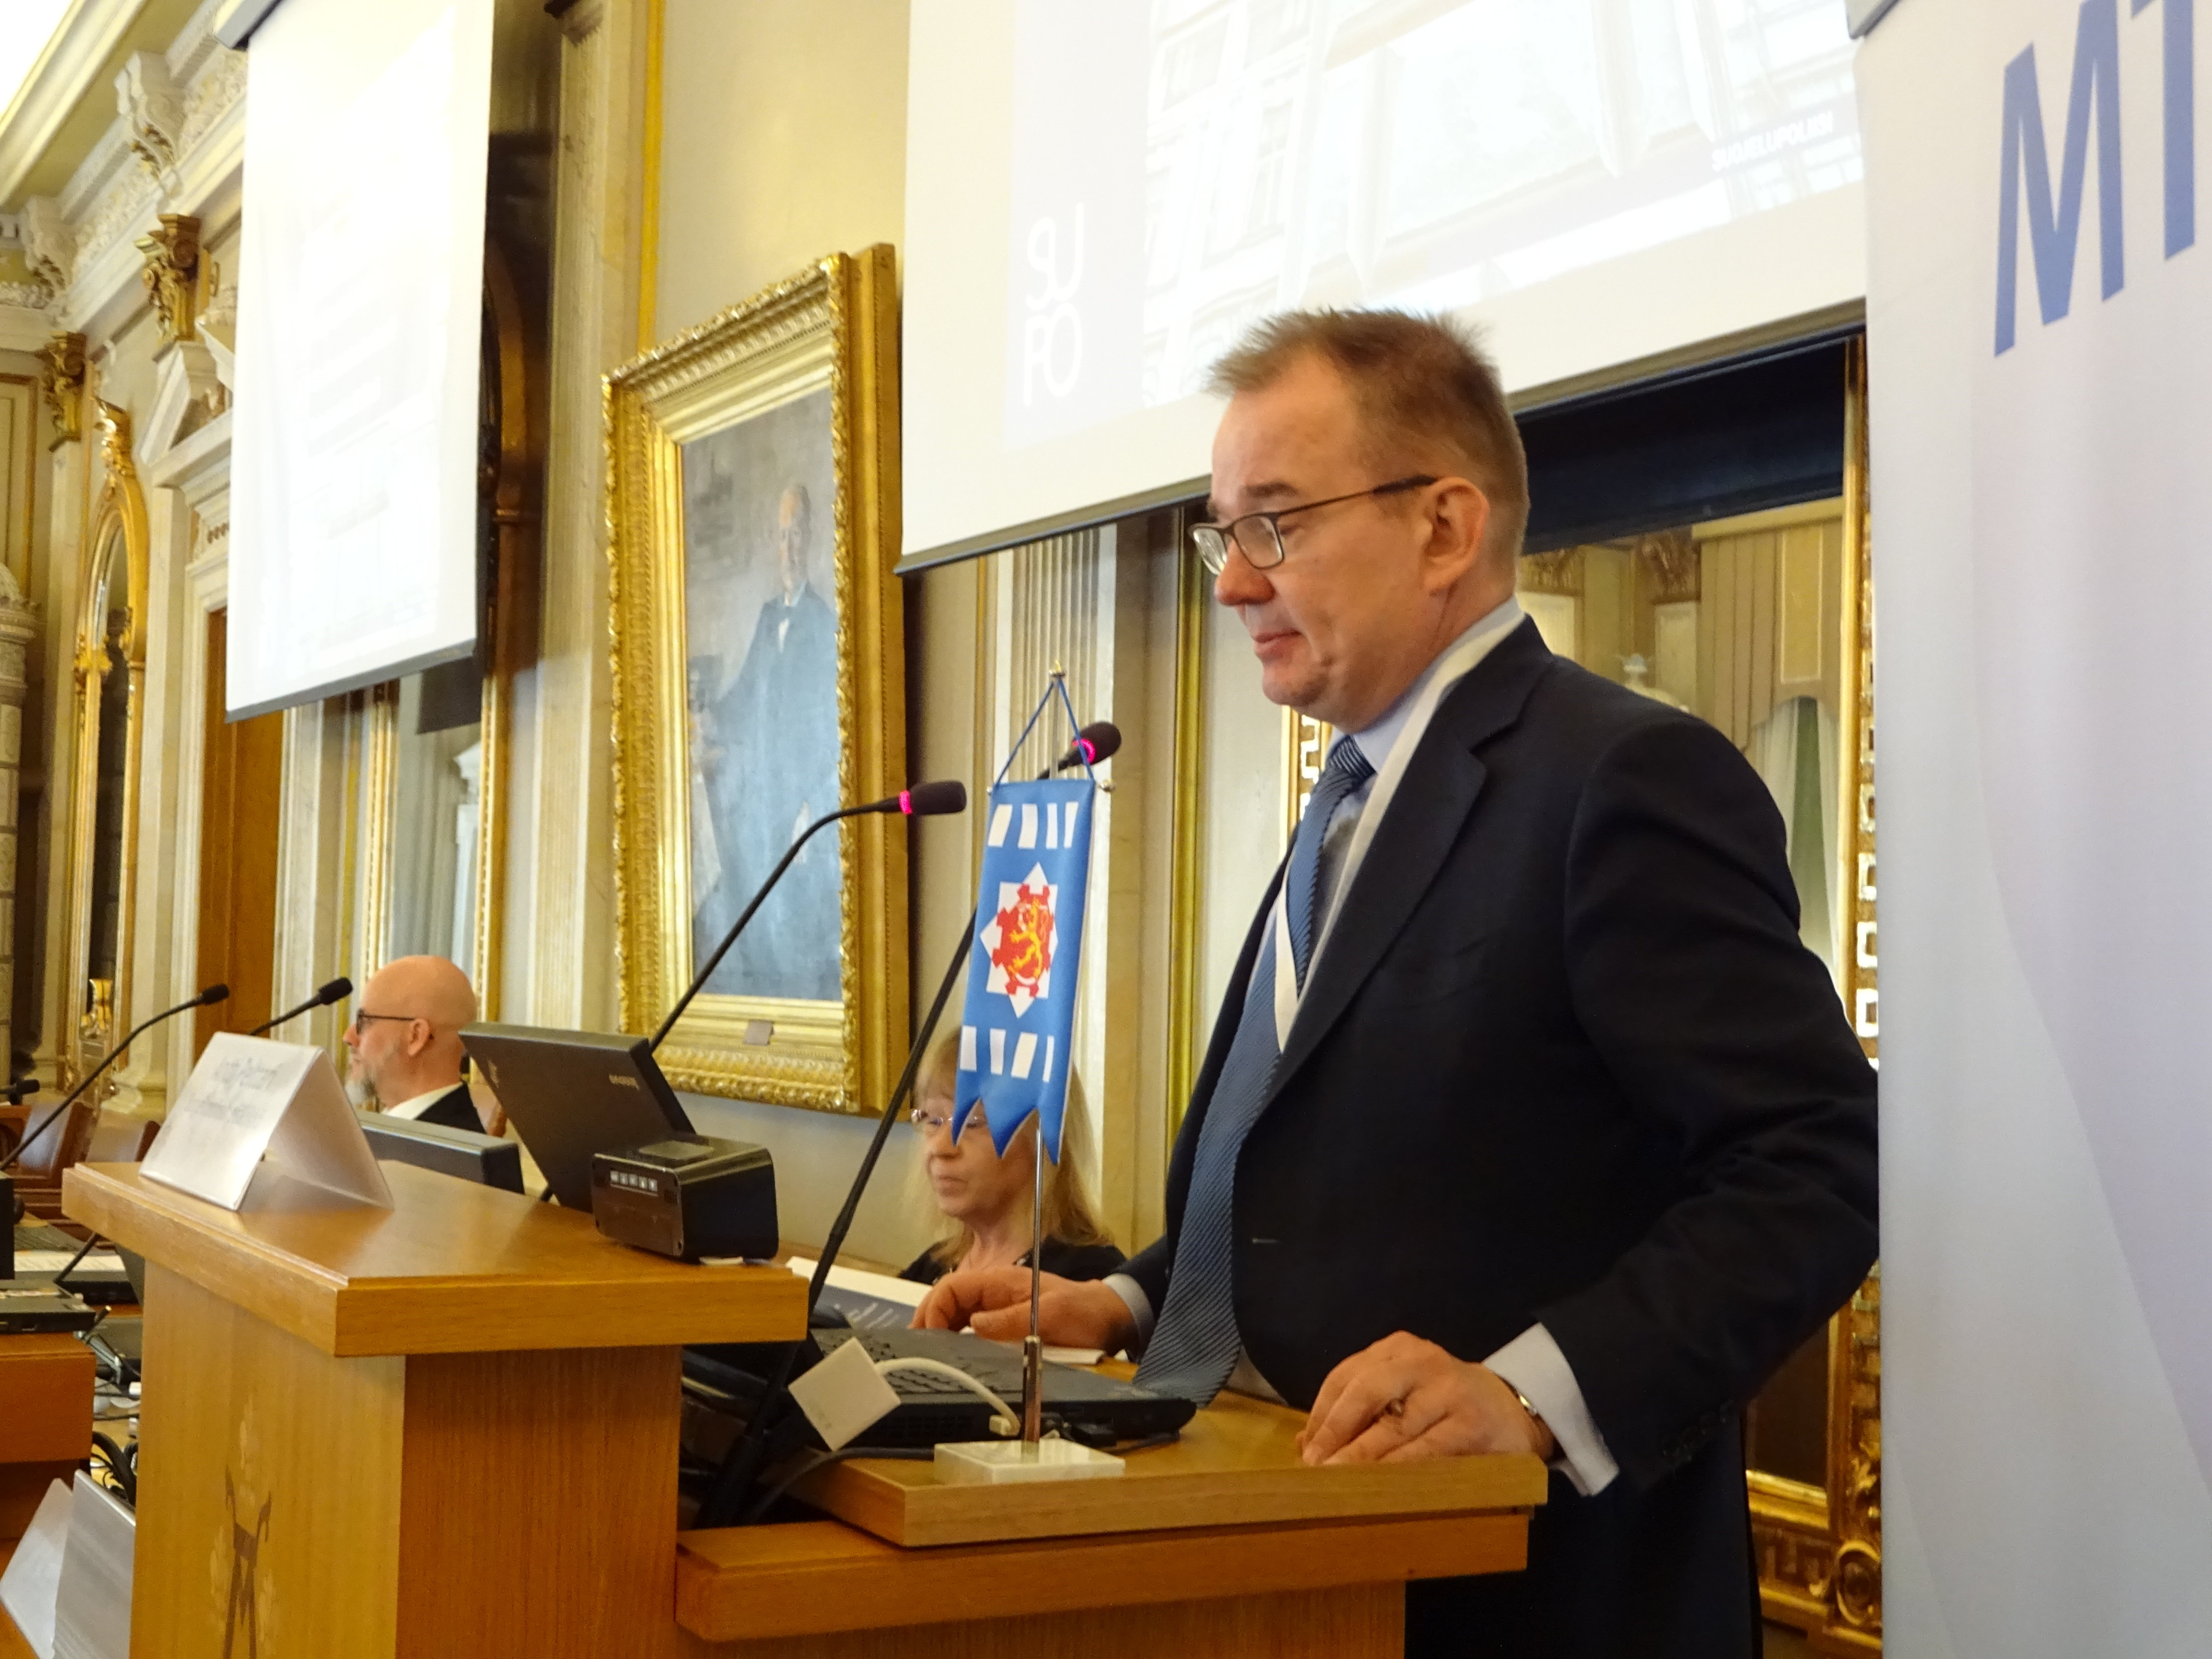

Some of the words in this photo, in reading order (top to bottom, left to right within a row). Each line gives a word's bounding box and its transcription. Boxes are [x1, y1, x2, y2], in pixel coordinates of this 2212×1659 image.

[1712, 111, 1833, 172] SUOJELUPOLIISI
[1027, 202, 1083, 309] SU
[1024, 303, 1083, 406] PO
